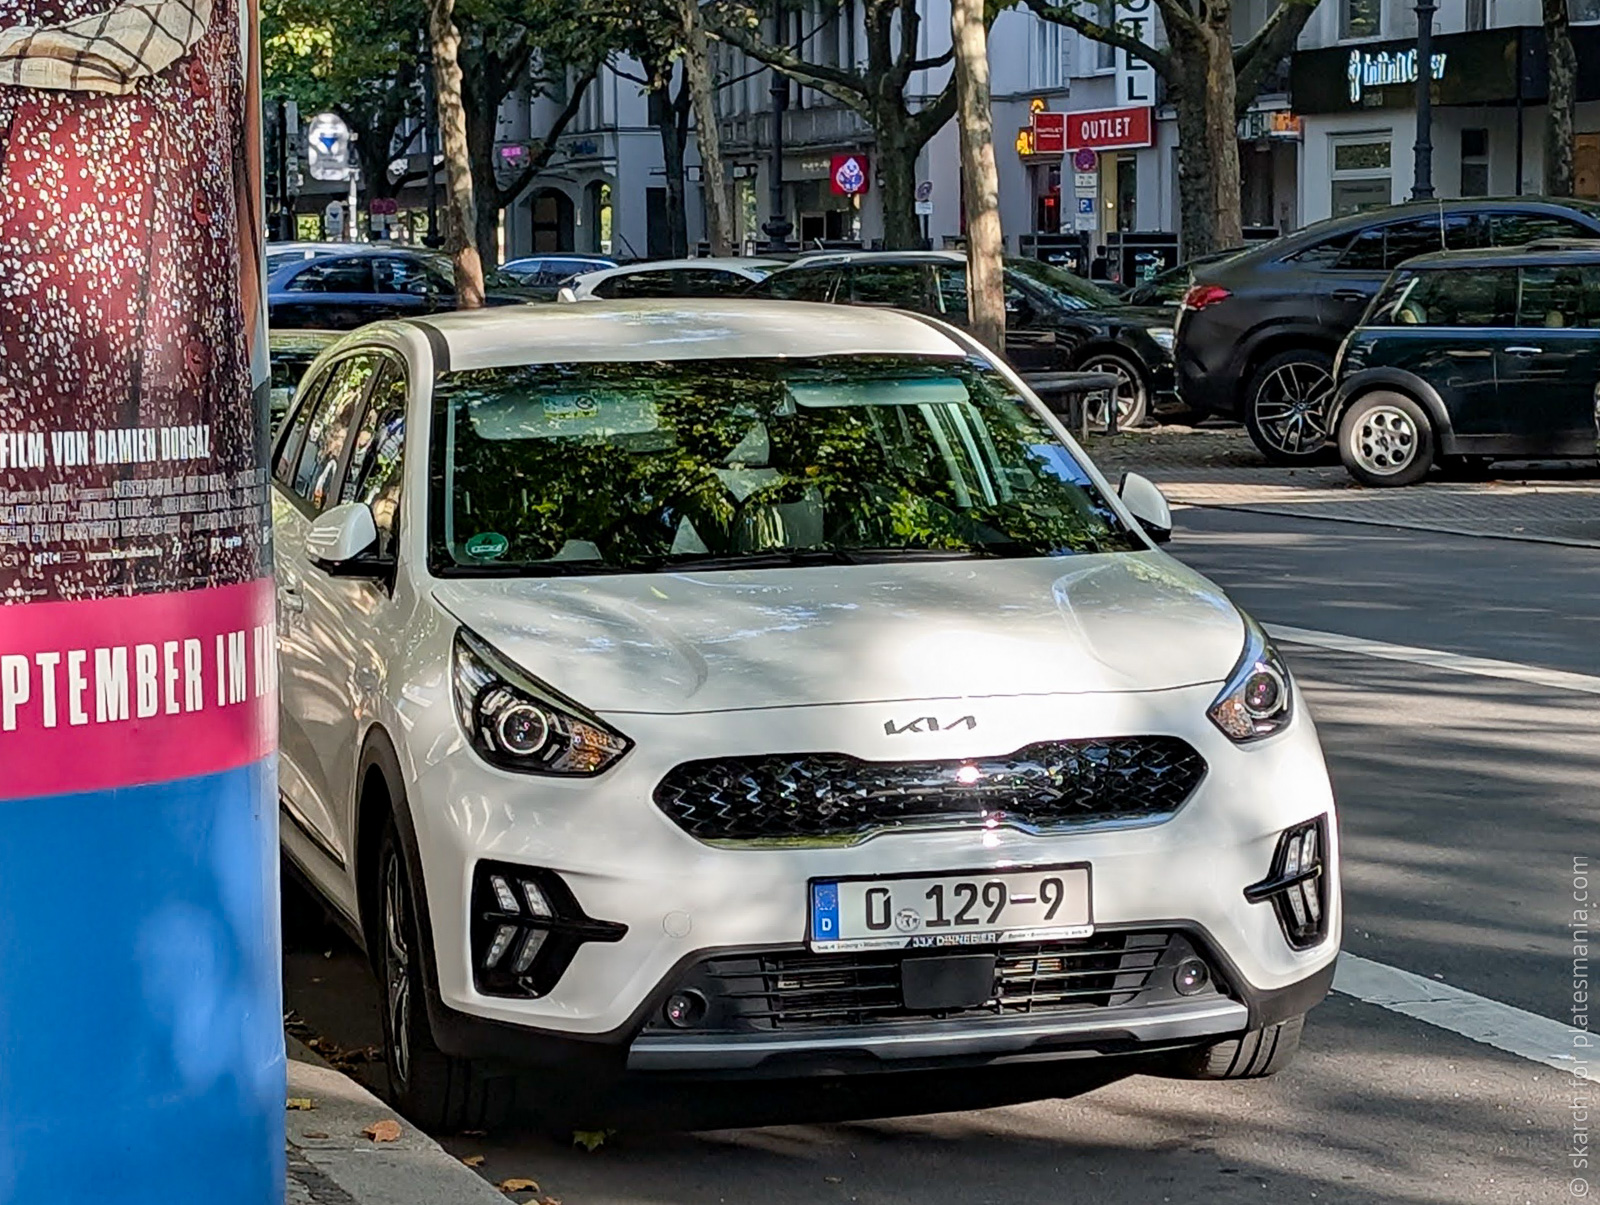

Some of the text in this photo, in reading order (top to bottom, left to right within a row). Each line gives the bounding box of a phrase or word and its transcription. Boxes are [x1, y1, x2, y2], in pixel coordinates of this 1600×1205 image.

[1081, 117, 1130, 140] OUTLET
[0, 425, 210, 468] FILM VON DAMIEN DORSAZ
[1, 638, 203, 731] PTEMBER
[216, 630, 246, 706] IM
[925, 877, 1065, 928] 129-9
[822, 918, 832, 931] D
